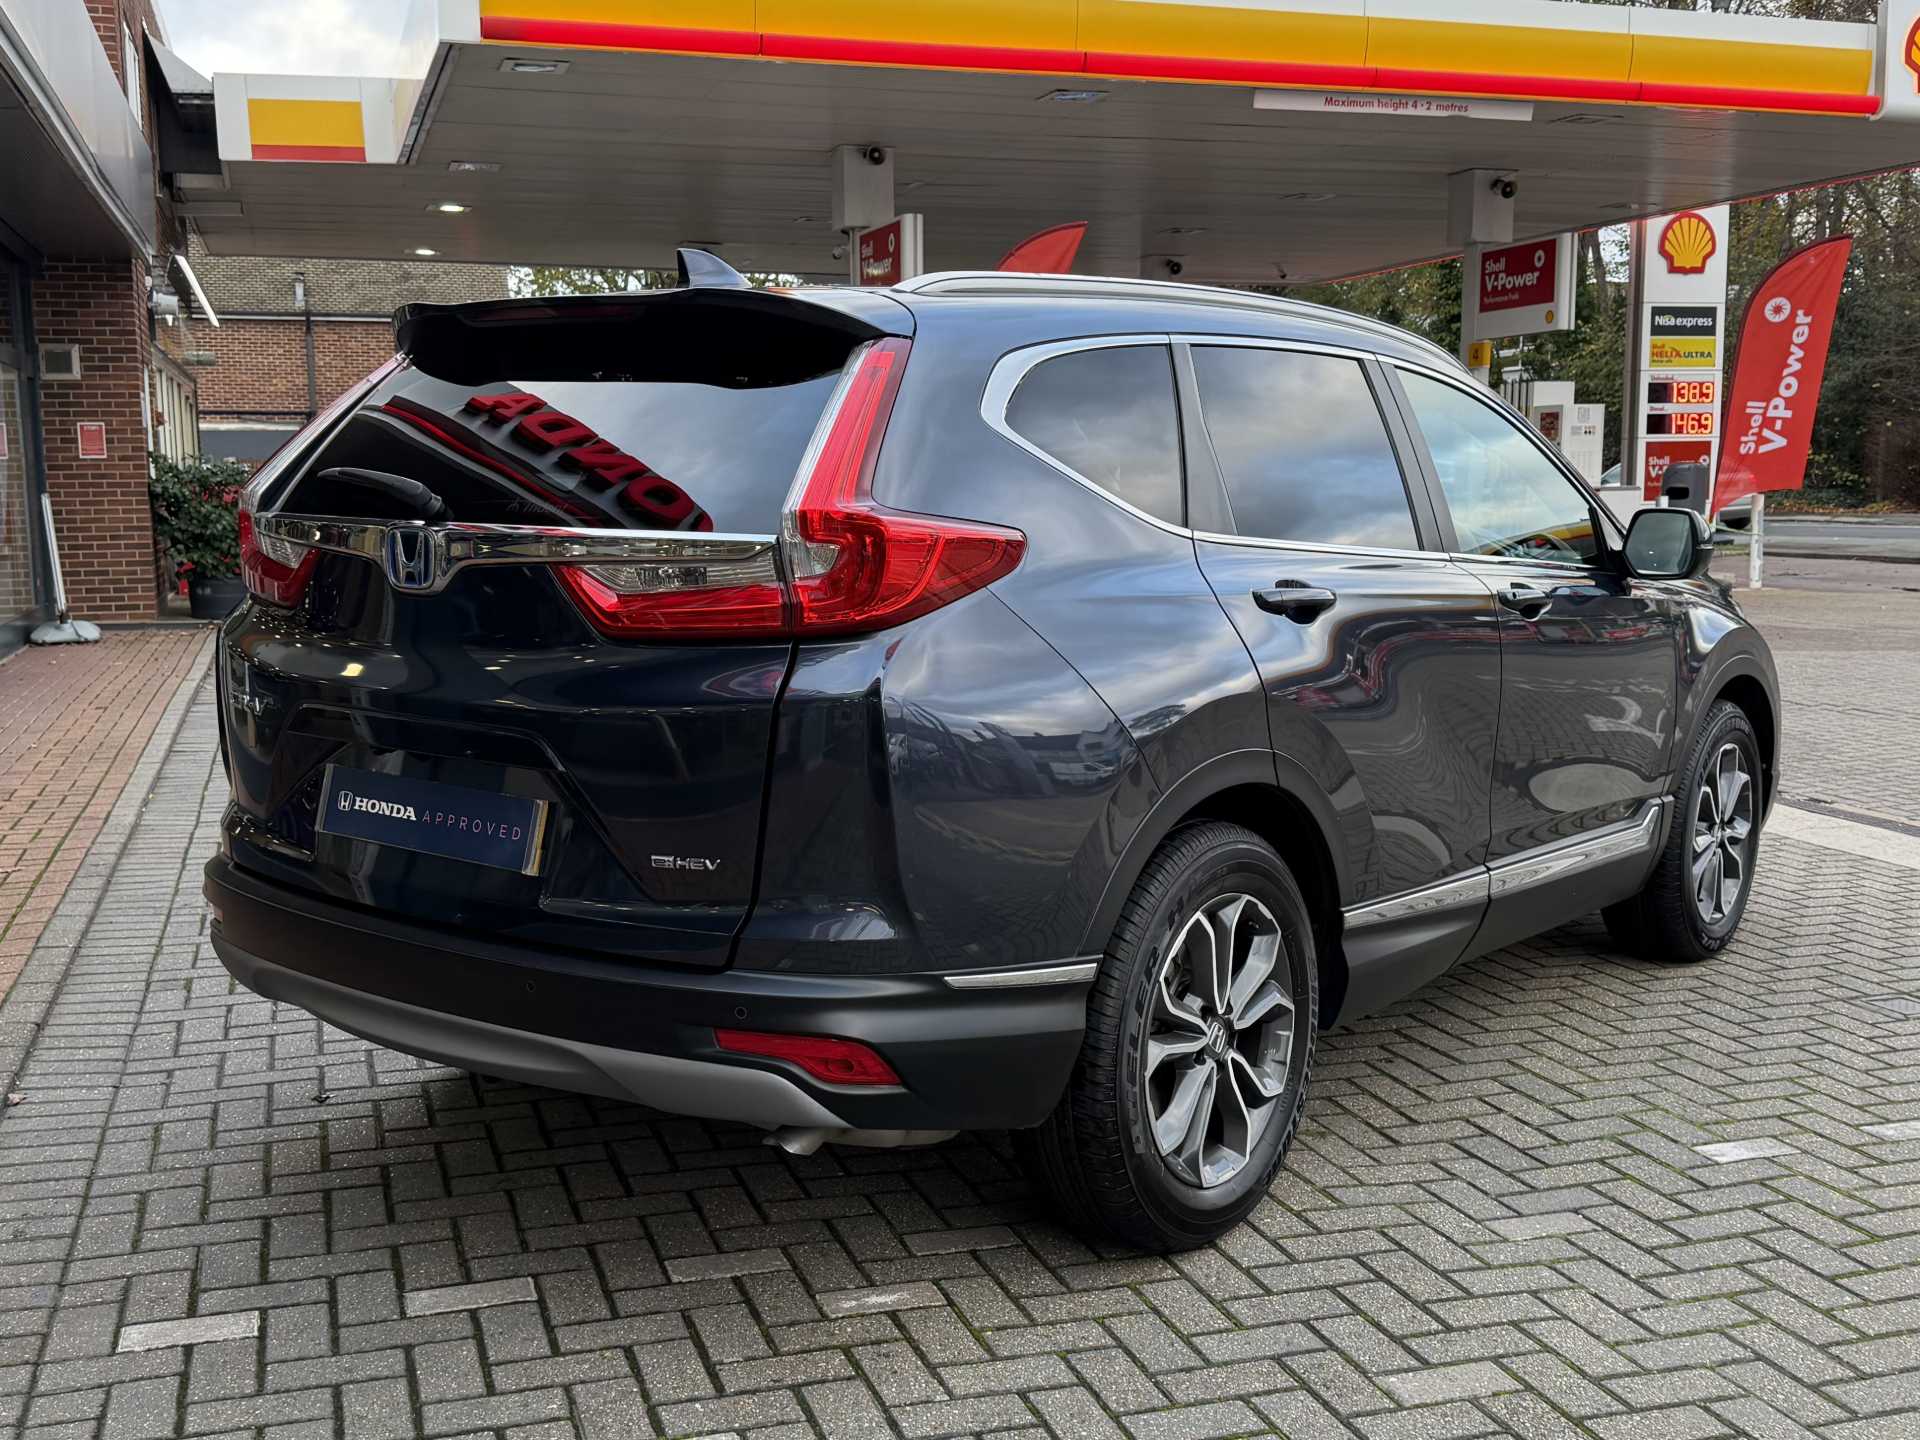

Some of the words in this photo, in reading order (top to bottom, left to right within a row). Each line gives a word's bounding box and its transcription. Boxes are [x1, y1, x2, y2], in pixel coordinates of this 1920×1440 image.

[1323, 96, 1375, 109] Maximum
[1377, 99, 1409, 112] height
[1435, 103, 1469, 113] metres
[1485, 258, 1505, 273] Shell
[1485, 271, 1540, 292] V-Power
[1676, 317, 1713, 328] express
[1472, 348, 1479, 360] 4
[1683, 351, 1713, 359] ULTRA
[1758, 309, 1813, 454] V-Power
[1673, 382, 1714, 403] 138.9
[1671, 413, 1712, 434] 146.9
[1739, 401, 1767, 455] Shell
[1648, 455, 1670, 465] Shell
[353, 796, 417, 821] HONDA
[422, 810, 521, 840] APPROVED
